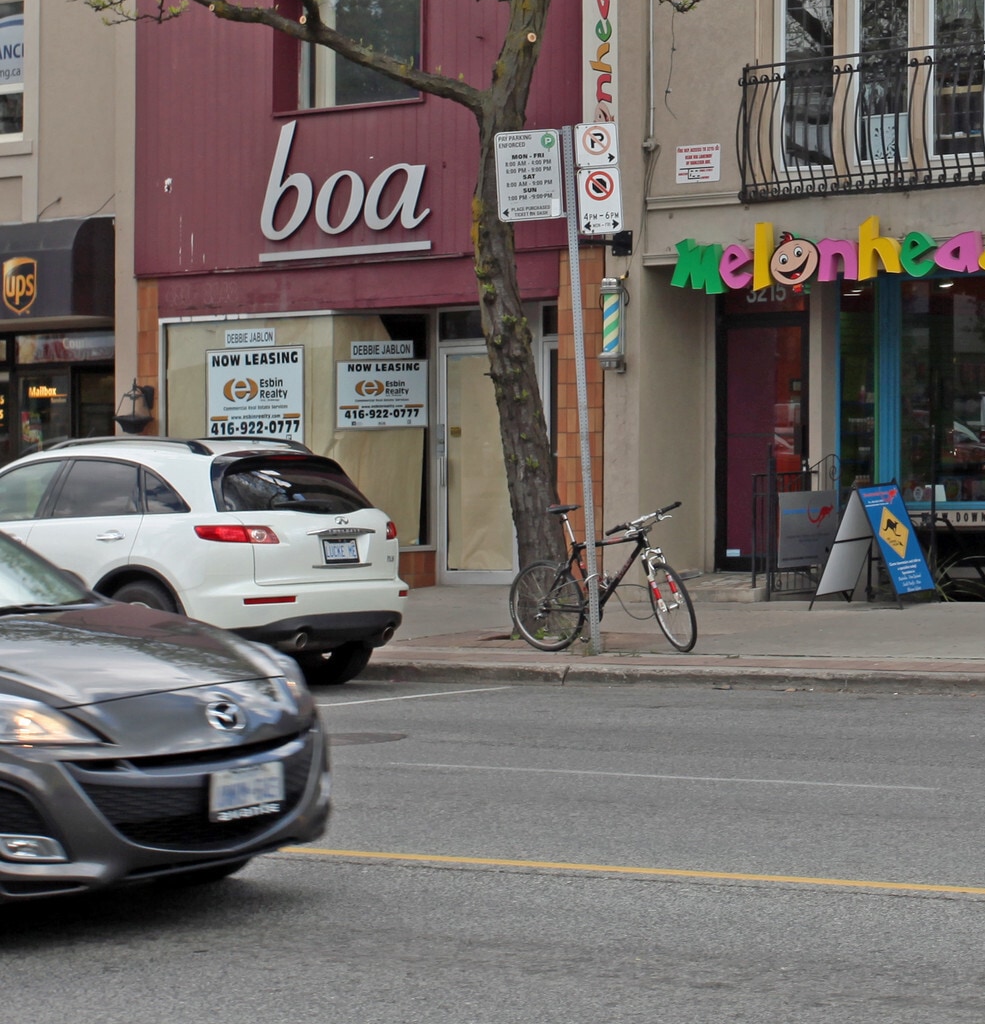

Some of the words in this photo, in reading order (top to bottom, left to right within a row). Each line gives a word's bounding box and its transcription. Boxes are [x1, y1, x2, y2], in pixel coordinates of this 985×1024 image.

[260, 119, 431, 241] boa
[583, 212, 598, 221] 4PM
[605, 211, 620, 220] 6PM
[5, 274, 35, 306] ups
[746, 284, 787, 305] 3215
[226, 333, 248, 344] DEBBIE
[249, 332, 274, 343] JABLON
[353, 344, 380, 356] DEBBIE
[381, 343, 411, 355] JABLON
[212, 354, 241, 368] NOW
[245, 351, 299, 366] LEASING
[347, 363, 372, 372] NOW
[375, 362, 420, 372] LEASING
[259, 377, 283, 388] Esbin
[28, 386, 57, 398] Mailbox
[259, 388, 288, 400] Realty
[385, 387, 409, 395] Realty
[344, 408, 420, 419] 416-922-0777
[211, 420, 300, 436] 416-922-0777
